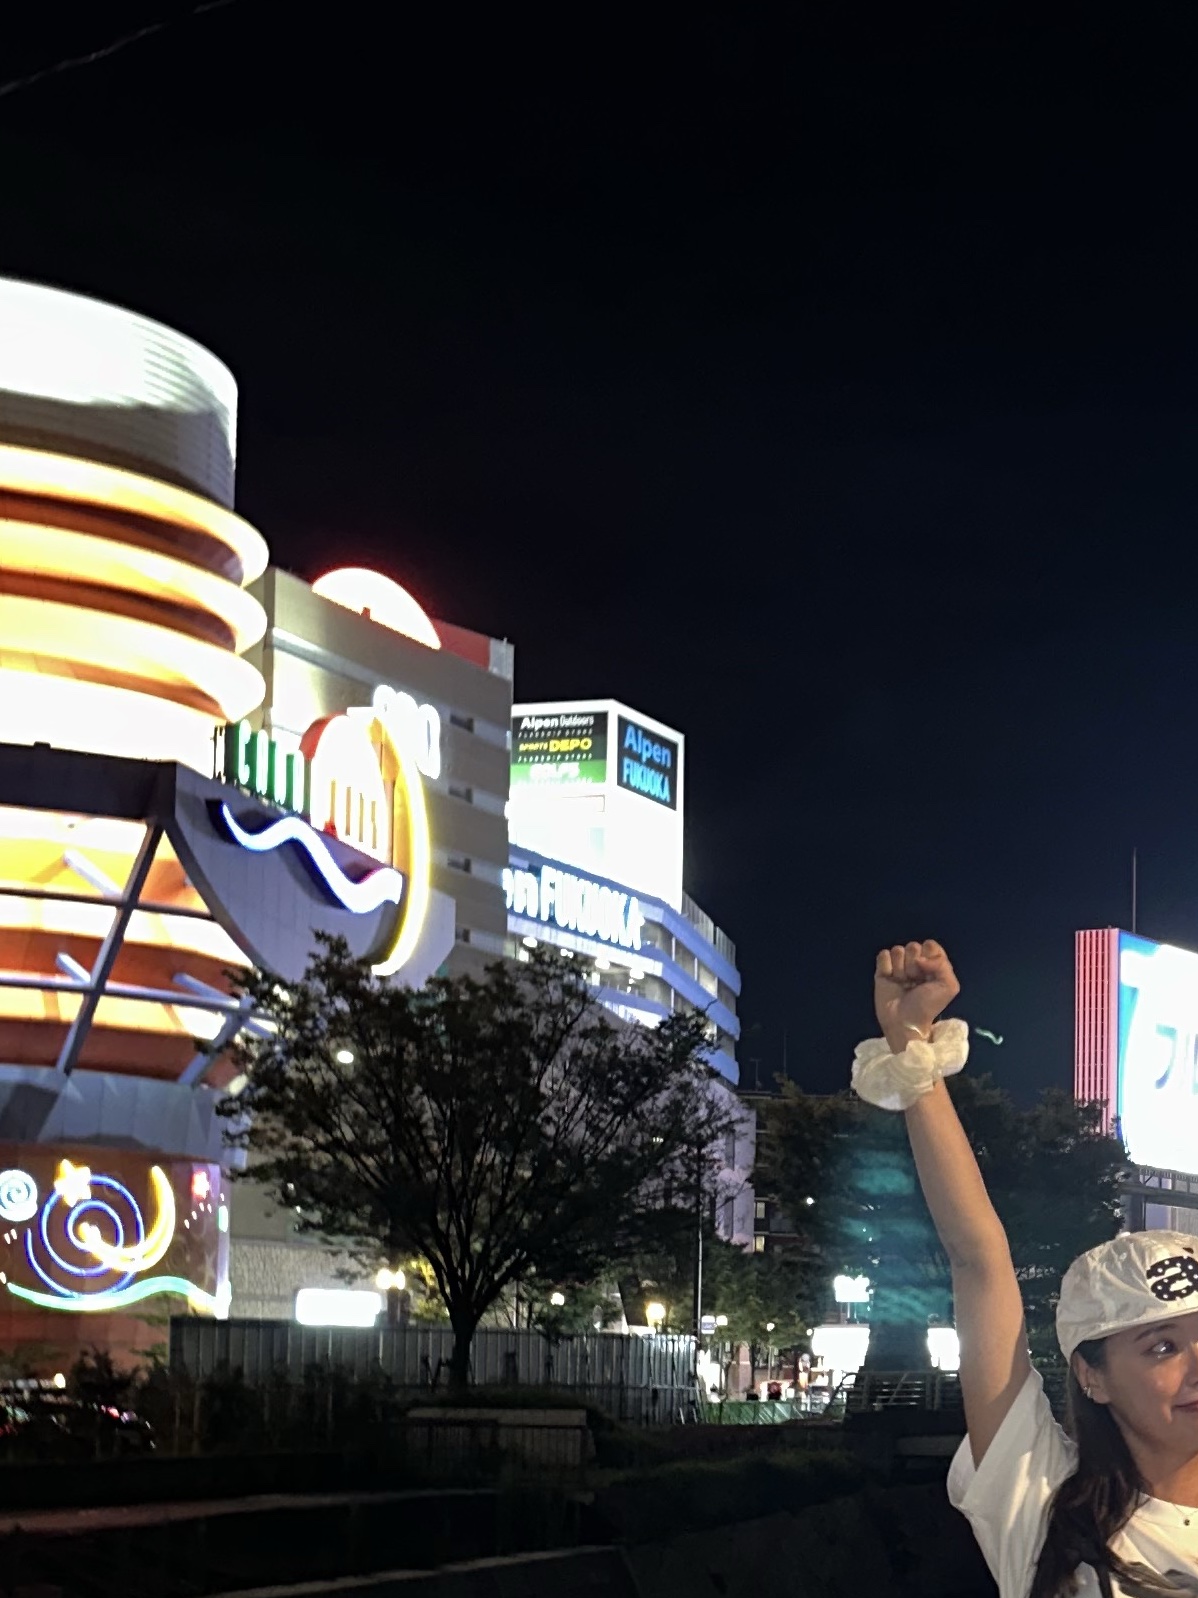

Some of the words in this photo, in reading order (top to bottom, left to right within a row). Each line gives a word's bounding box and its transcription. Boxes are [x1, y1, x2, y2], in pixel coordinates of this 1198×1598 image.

[520, 715, 559, 732] Alpen
[549, 737, 592, 753] DEPO
[624, 724, 672, 768] Alpen
[622, 756, 671, 803] FUKUOKA
[540, 864, 642, 951] FUKUOKA
